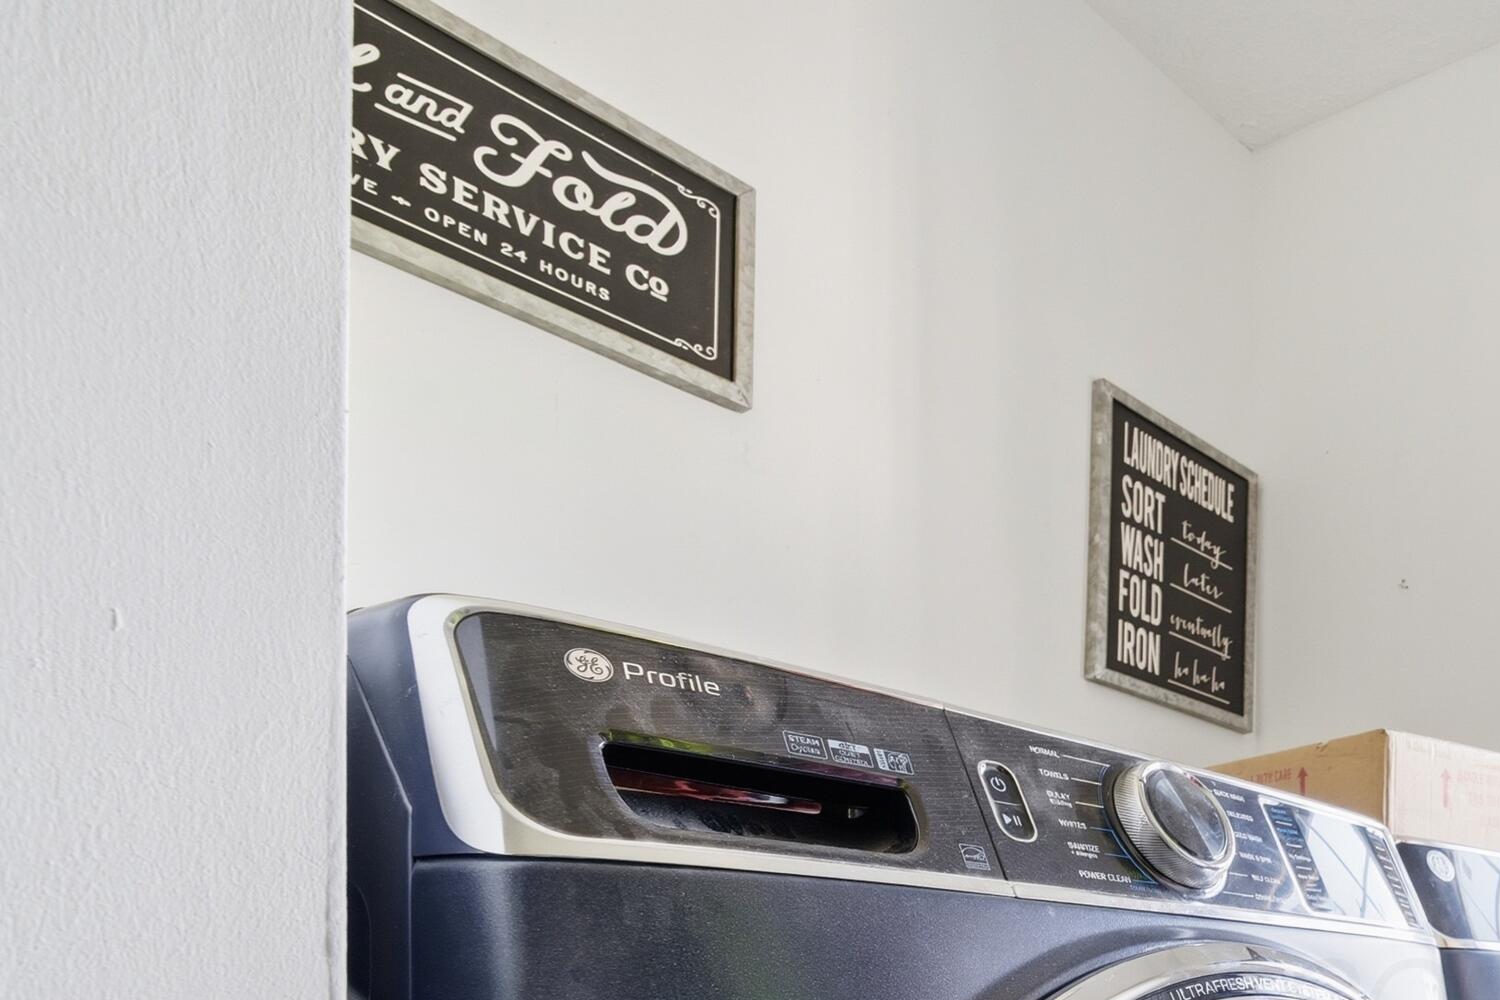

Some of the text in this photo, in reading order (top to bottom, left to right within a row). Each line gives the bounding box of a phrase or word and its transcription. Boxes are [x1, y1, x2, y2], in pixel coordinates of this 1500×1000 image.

[384, 84, 688, 256] and Fold
[419, 162, 612, 276] SERVICE
[423, 206, 489, 246] OPEN
[500, 241, 528, 264] 24
[539, 259, 611, 302] HOURS
[1123, 421, 1235, 523] LAUNDRY SCHEDULE
[1120, 521, 1224, 599] WASH later
[1121, 474, 1227, 569] SORT today
[1116, 619, 1226, 693] IRON ha ha ha
[1118, 569, 1233, 661] FOLD eventually
[622, 661, 721, 696] Profile
[1079, 869, 1132, 884] POWER CLEAN
